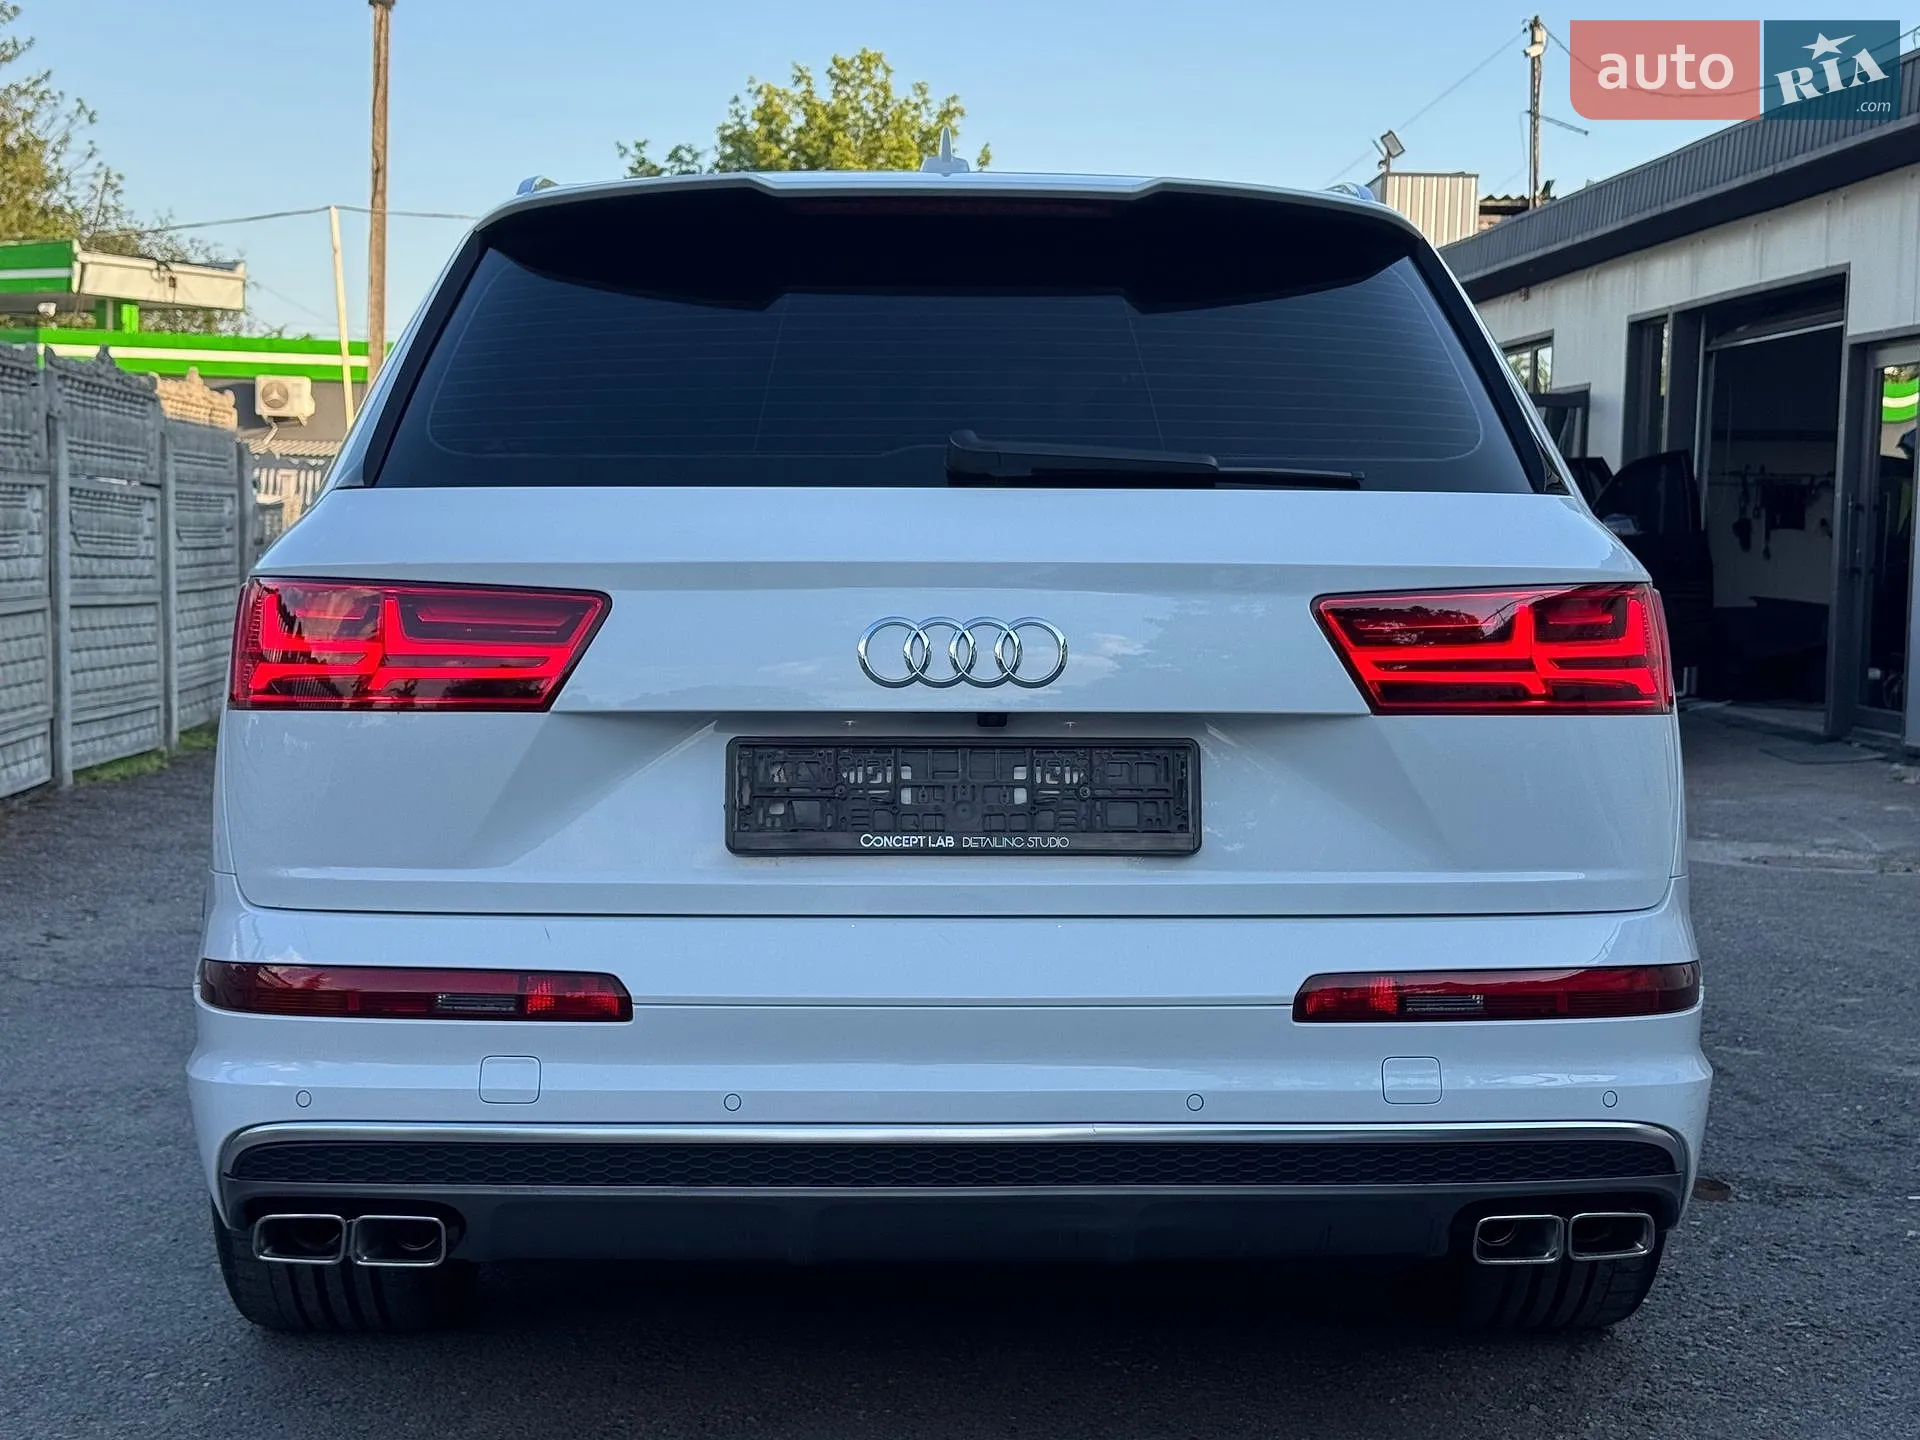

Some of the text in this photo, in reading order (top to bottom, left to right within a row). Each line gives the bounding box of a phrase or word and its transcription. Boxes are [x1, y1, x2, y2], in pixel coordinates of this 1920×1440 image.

[860, 833, 926, 848] CONCEPT
[928, 835, 955, 848] LAB
[1026, 836, 1070, 848] STUDIO
